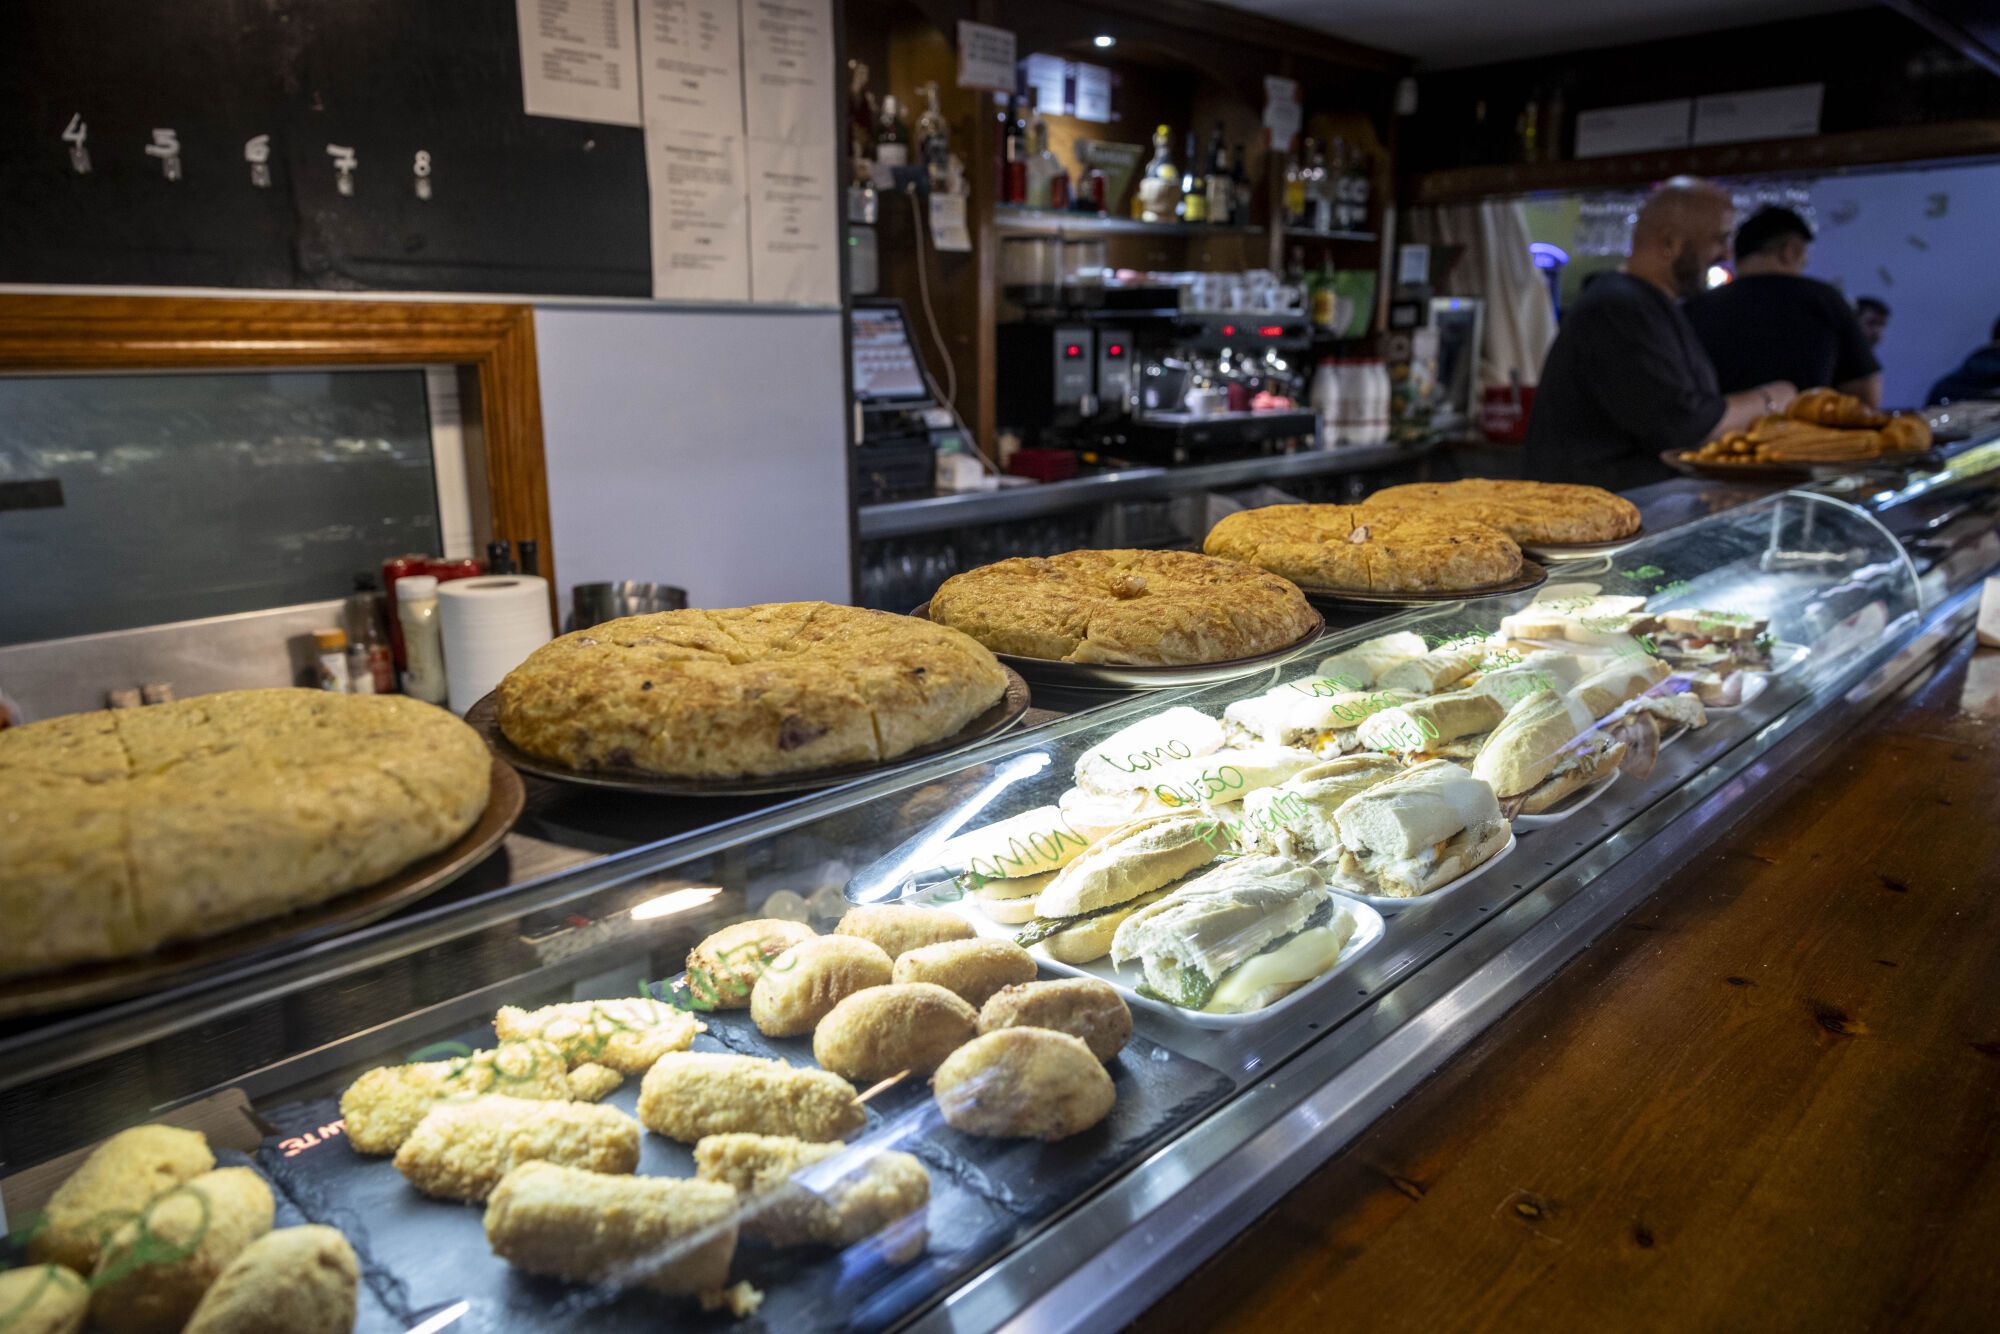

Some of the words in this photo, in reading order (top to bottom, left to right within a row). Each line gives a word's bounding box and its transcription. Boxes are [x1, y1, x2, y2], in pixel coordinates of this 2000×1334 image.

[62, 112, 88, 148] 4
[144, 127, 182, 158] 5
[244, 133, 271, 163] 6
[326, 142, 359, 176] 7
[412, 149, 432, 178] 8
[1331, 690, 1402, 721] QUESO
[1154, 765, 1245, 808] QUESO
[1193, 790, 1310, 850] PIMIENTO
[932, 808, 1088, 903] JAMON
